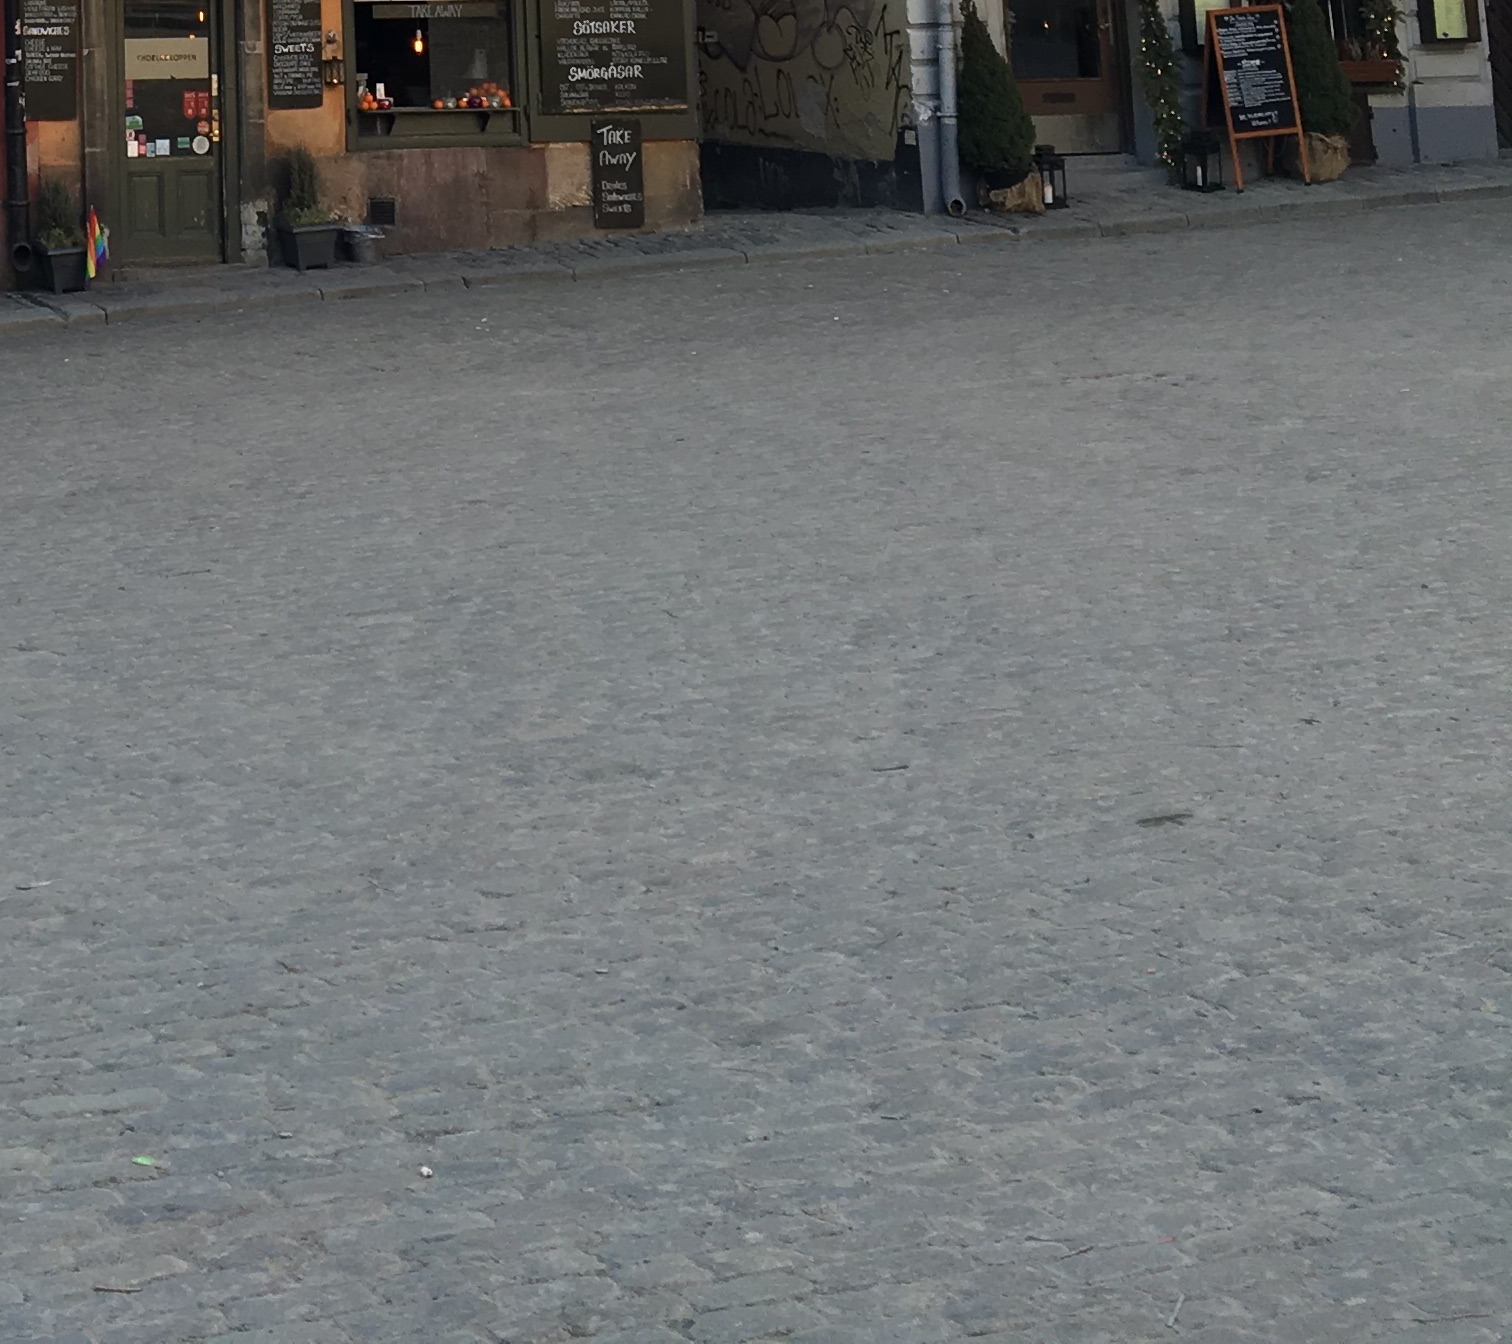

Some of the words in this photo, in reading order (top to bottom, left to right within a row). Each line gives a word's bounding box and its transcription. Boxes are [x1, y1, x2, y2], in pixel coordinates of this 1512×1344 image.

[573, 20, 636, 36] SÖTSAKER
[275, 43, 315, 54] SWEETS
[568, 63, 644, 81] SMÖRGÅSAR
